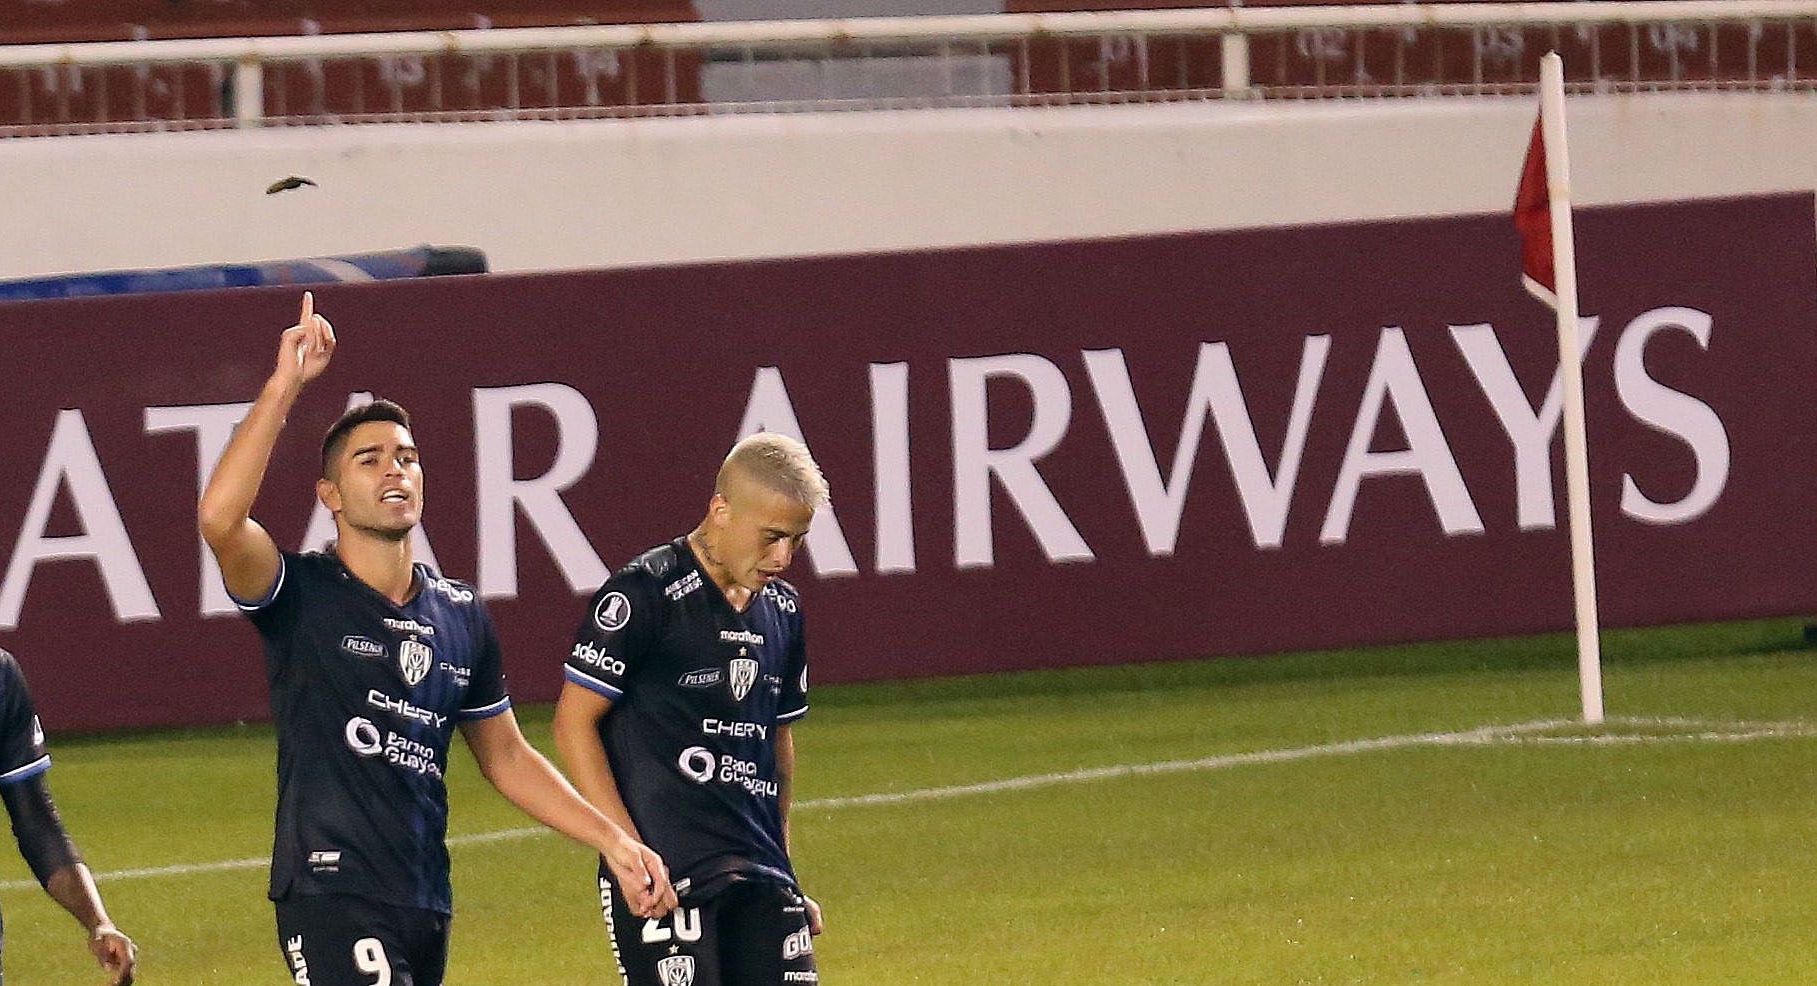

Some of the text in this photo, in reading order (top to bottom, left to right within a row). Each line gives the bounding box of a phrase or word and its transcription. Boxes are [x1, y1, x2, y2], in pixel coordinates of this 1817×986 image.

[383, 618, 435, 635] marathon
[720, 630, 764, 645] marathon
[368, 689, 447, 728] CHERY
[703, 718, 767, 740] CHERY
